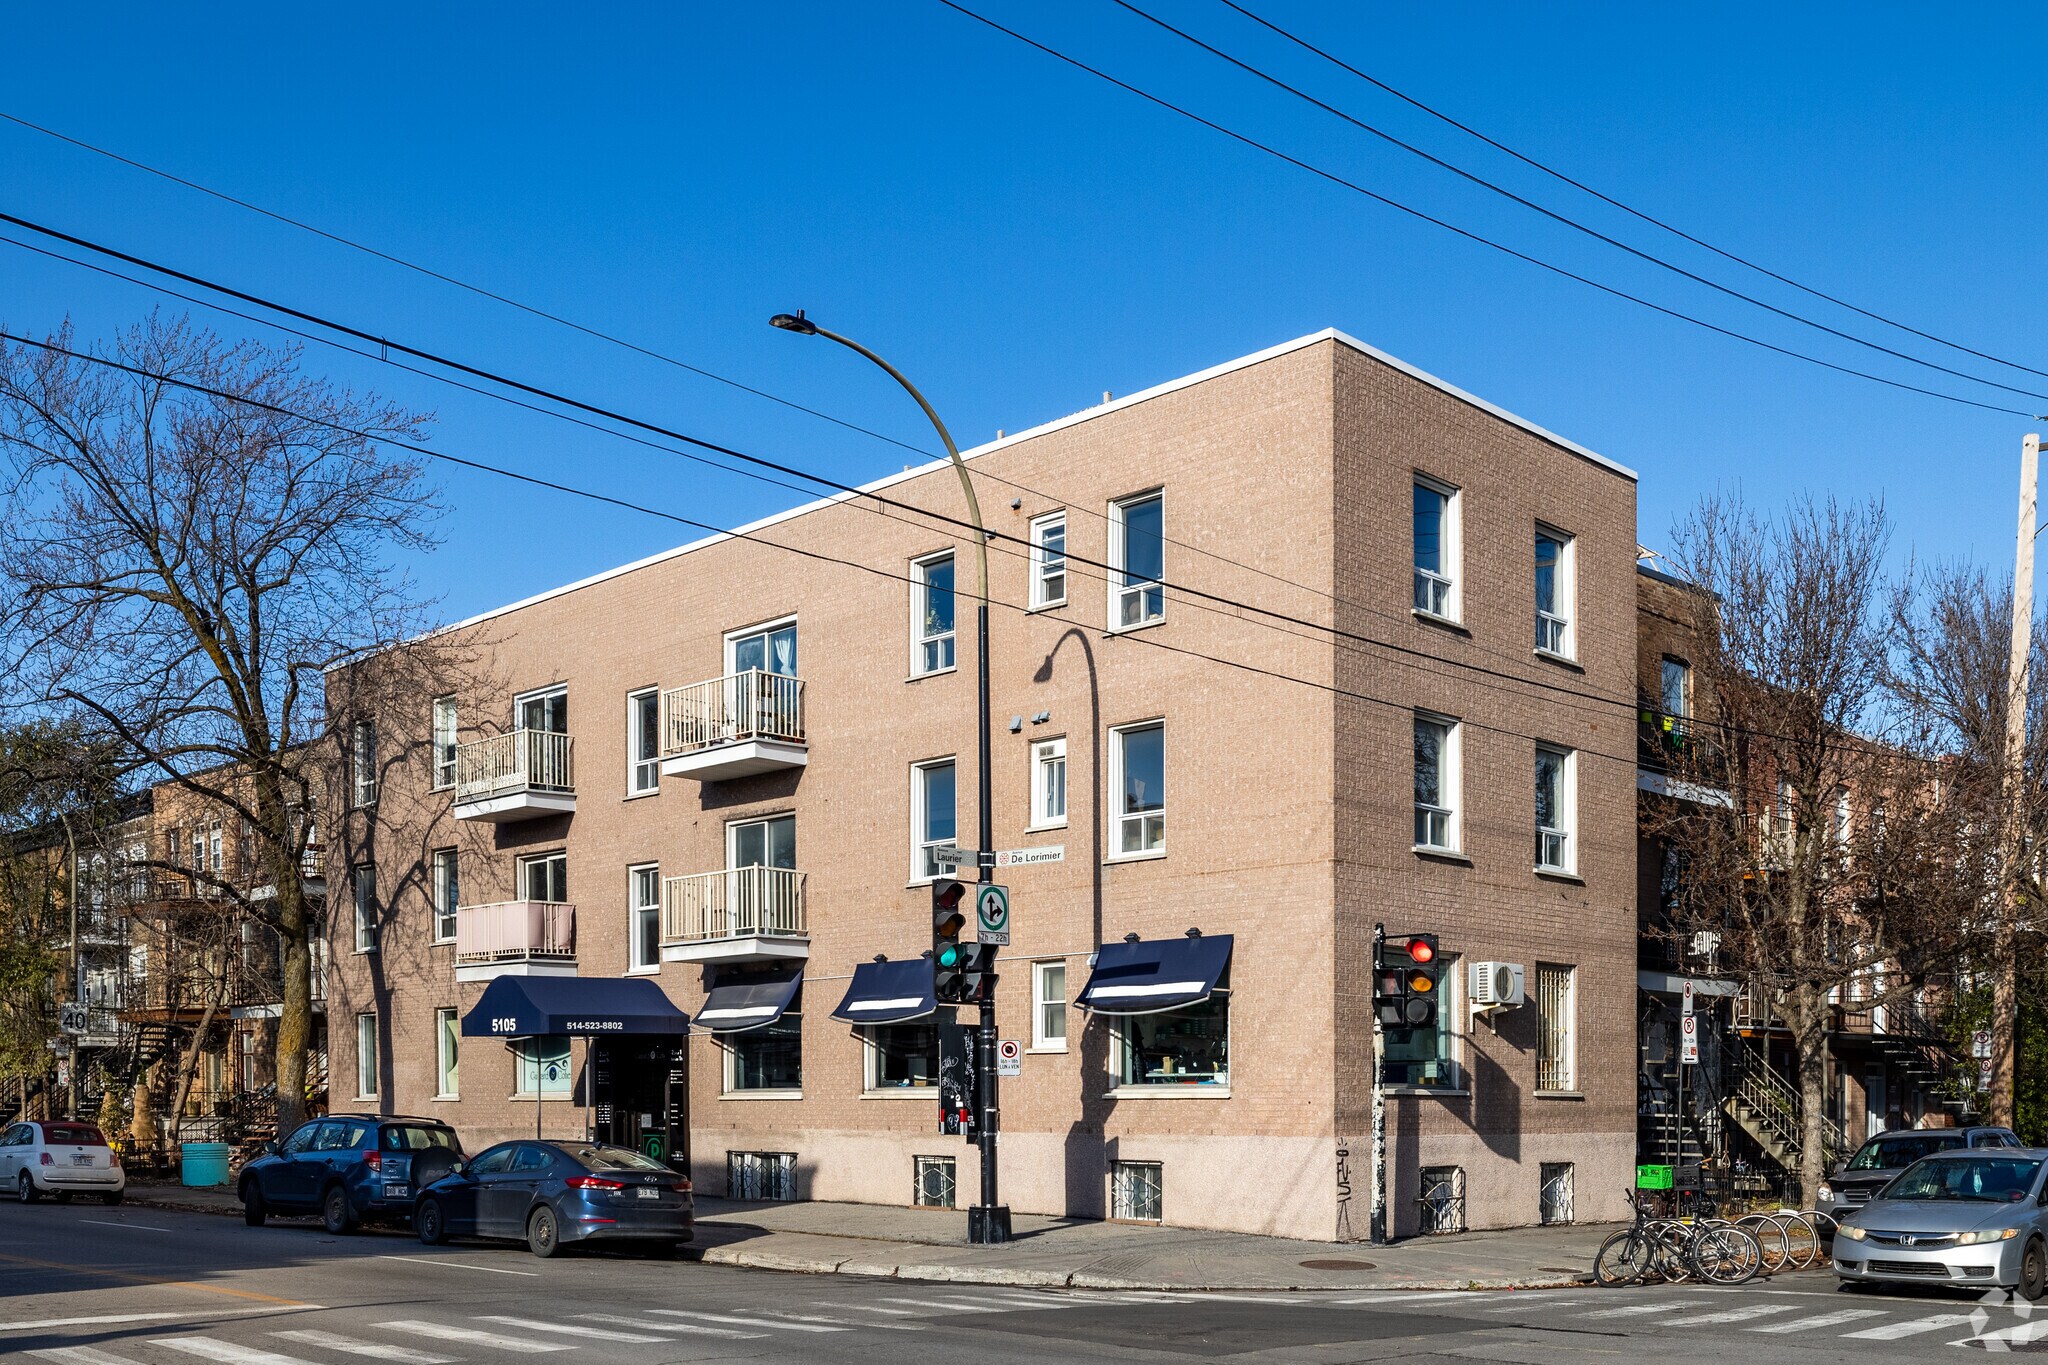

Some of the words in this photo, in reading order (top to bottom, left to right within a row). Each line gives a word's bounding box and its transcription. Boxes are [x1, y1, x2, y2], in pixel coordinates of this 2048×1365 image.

[937, 852, 962, 863] Laurier
[1011, 854, 1023, 864] De
[1026, 852, 1061, 862] Lorimier
[981, 933, 988, 941] 7h
[995, 933, 1007, 942] 22h
[62, 1012, 86, 1029] 40
[492, 1018, 517, 1032] 5105
[566, 1021, 623, 1030] 514-523-8802
[557, 1068, 571, 1081] Cohe
